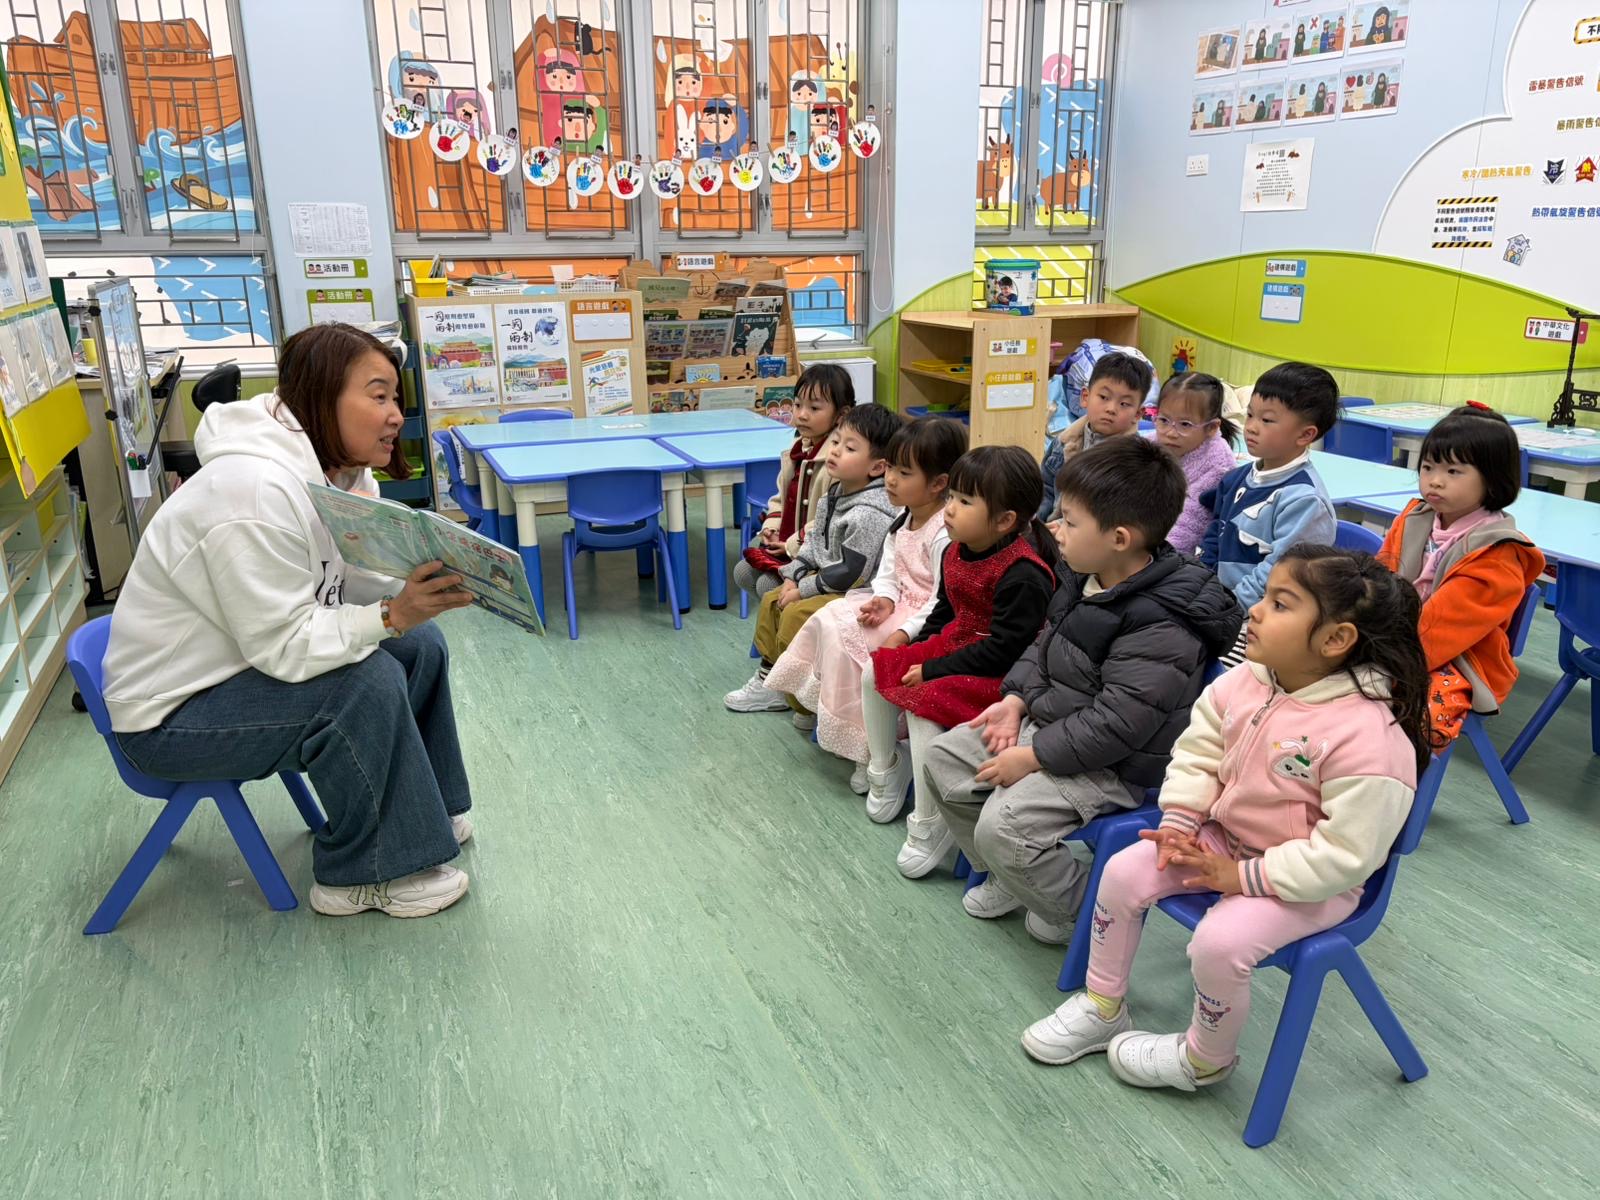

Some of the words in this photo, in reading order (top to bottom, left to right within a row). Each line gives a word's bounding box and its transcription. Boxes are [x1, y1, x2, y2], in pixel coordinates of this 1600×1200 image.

[1529, 75, 1584, 91] 雷暴警告信號
[323, 263, 349, 273] 活動冊
[327, 291, 353, 300] 活動冊
[1543, 321, 1570, 330] 中華文化
[1548, 330, 1562, 338] 遊戲
